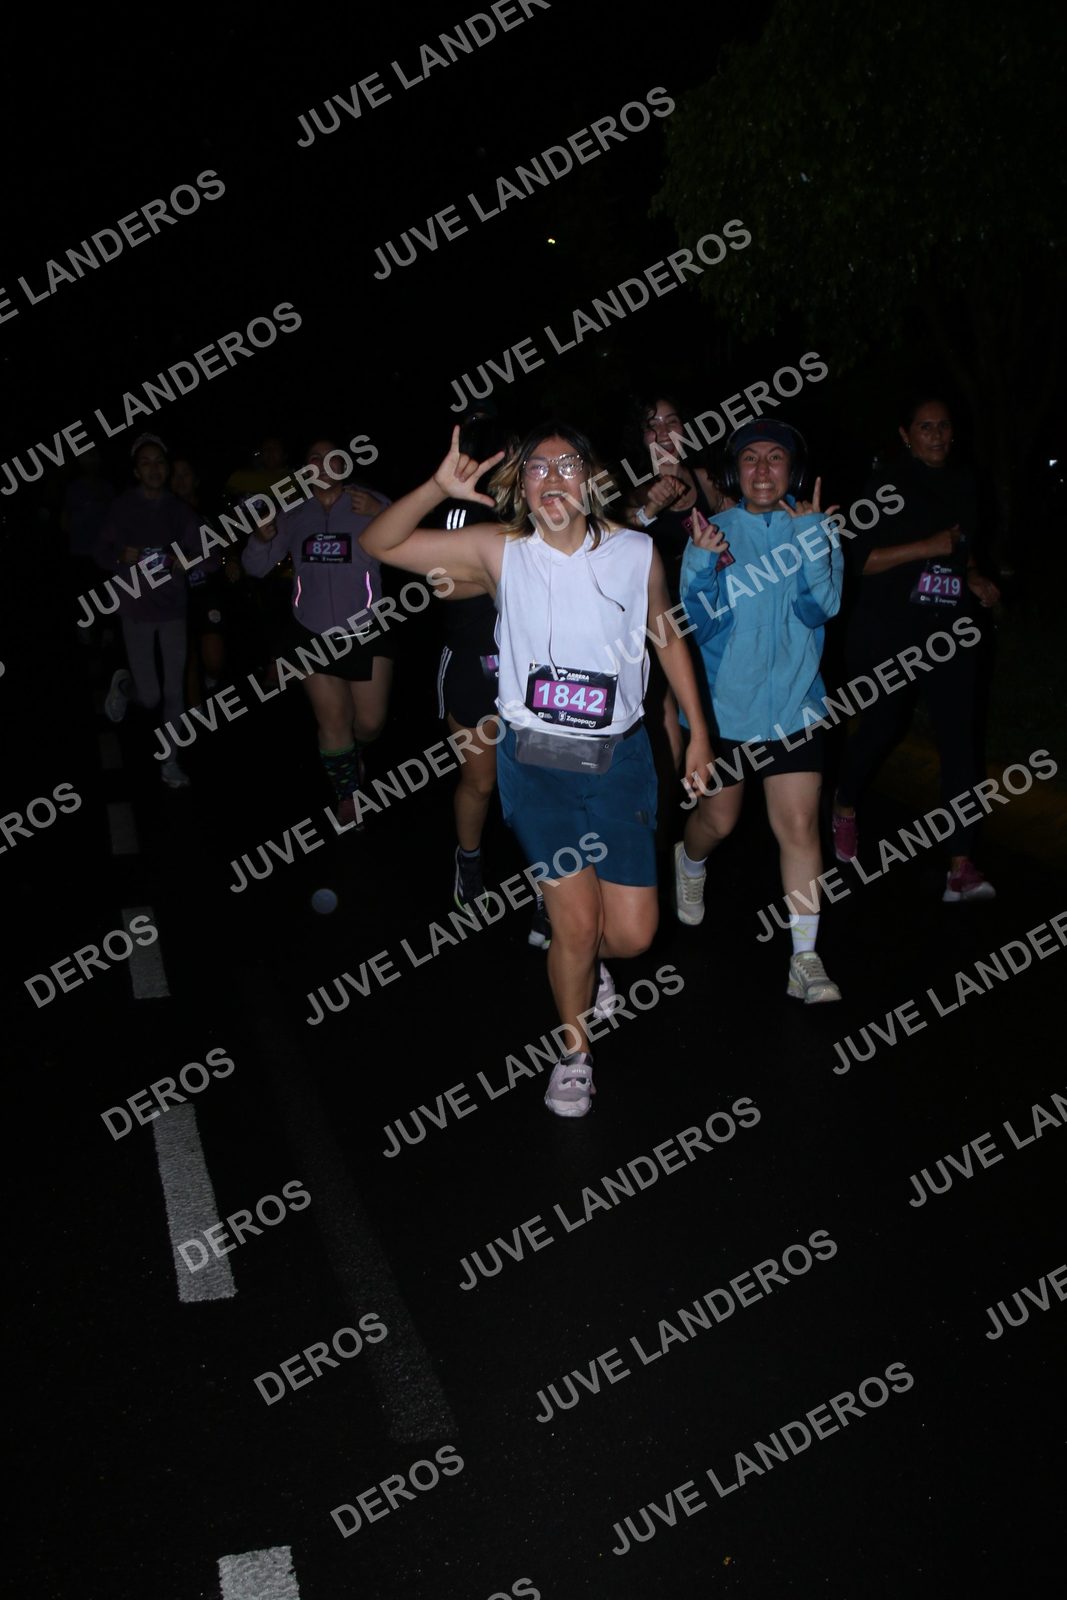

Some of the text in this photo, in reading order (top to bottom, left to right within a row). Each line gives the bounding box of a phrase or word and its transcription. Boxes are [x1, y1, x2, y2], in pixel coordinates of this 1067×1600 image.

[312, 541, 341, 555] 822
[923, 575, 961, 596] 1219
[538, 682, 605, 711] 1842
